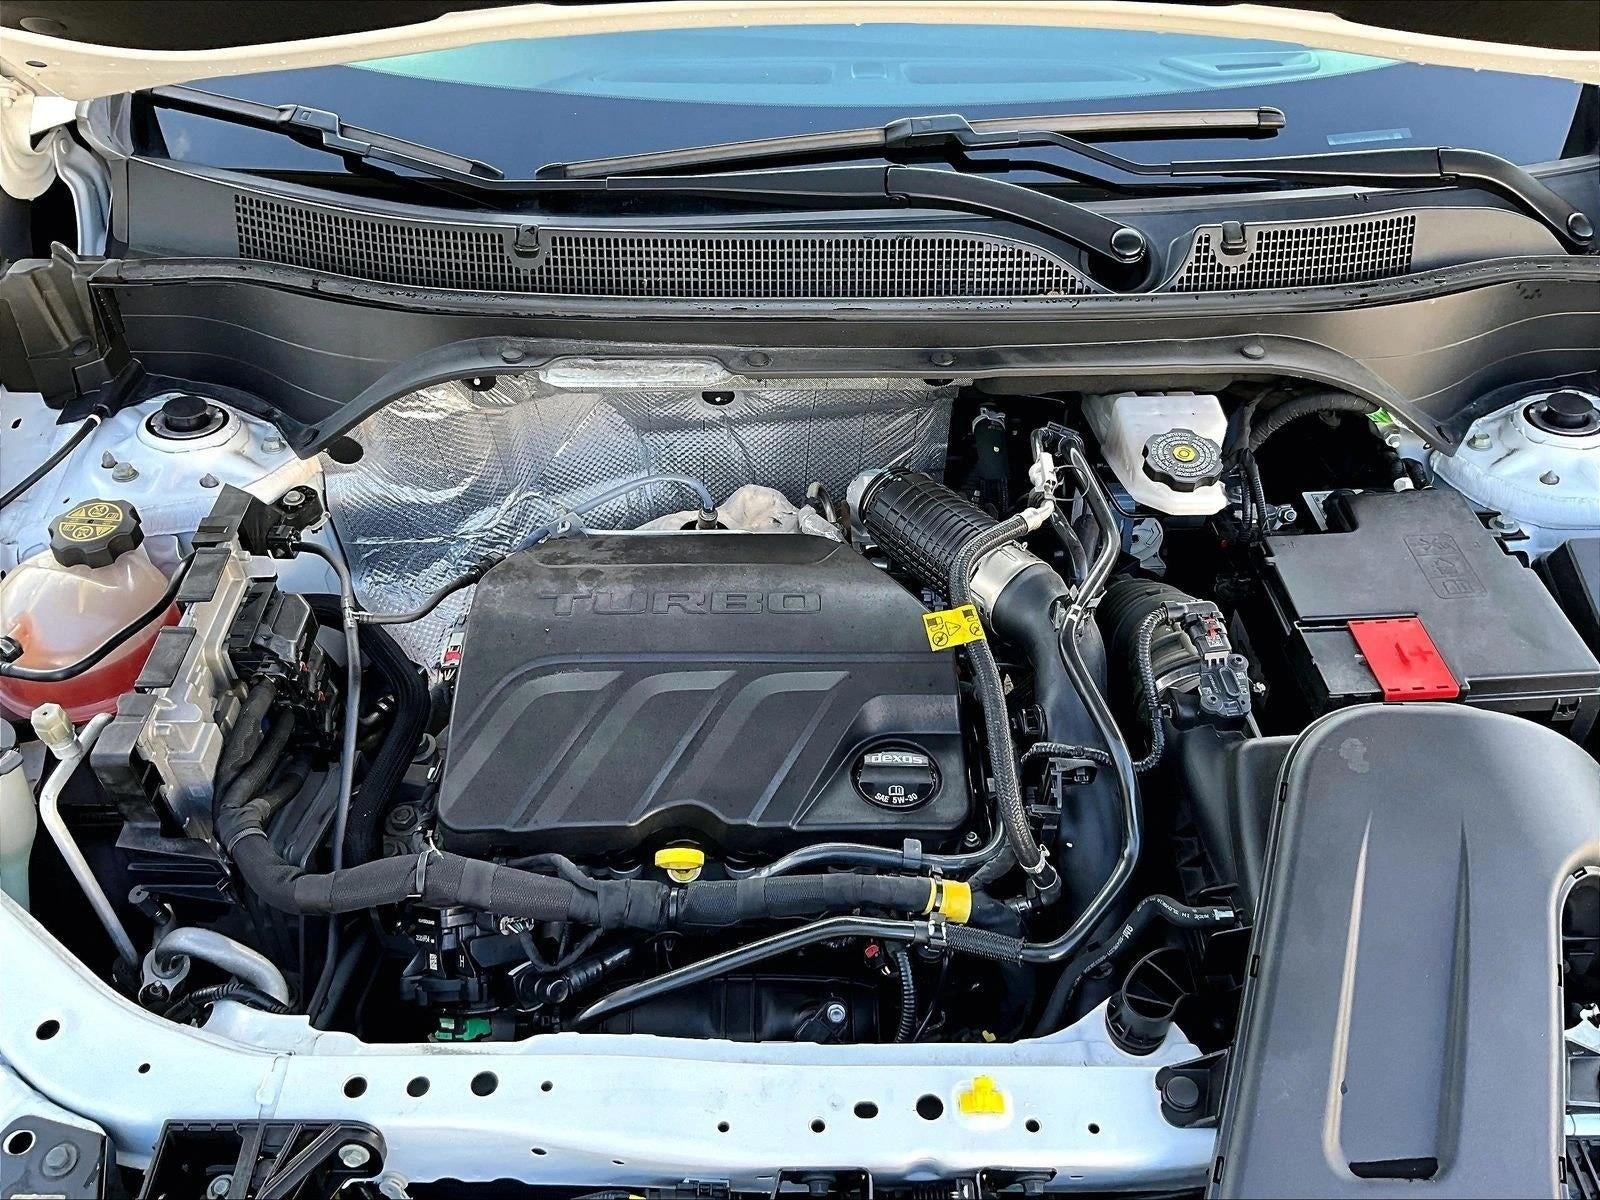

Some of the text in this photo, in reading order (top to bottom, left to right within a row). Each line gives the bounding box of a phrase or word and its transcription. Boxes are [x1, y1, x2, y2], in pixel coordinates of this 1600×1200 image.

[538, 591, 822, 617] TURBO
[871, 752, 923, 764] dexos
[874, 792, 918, 804] SAE 5W-30
